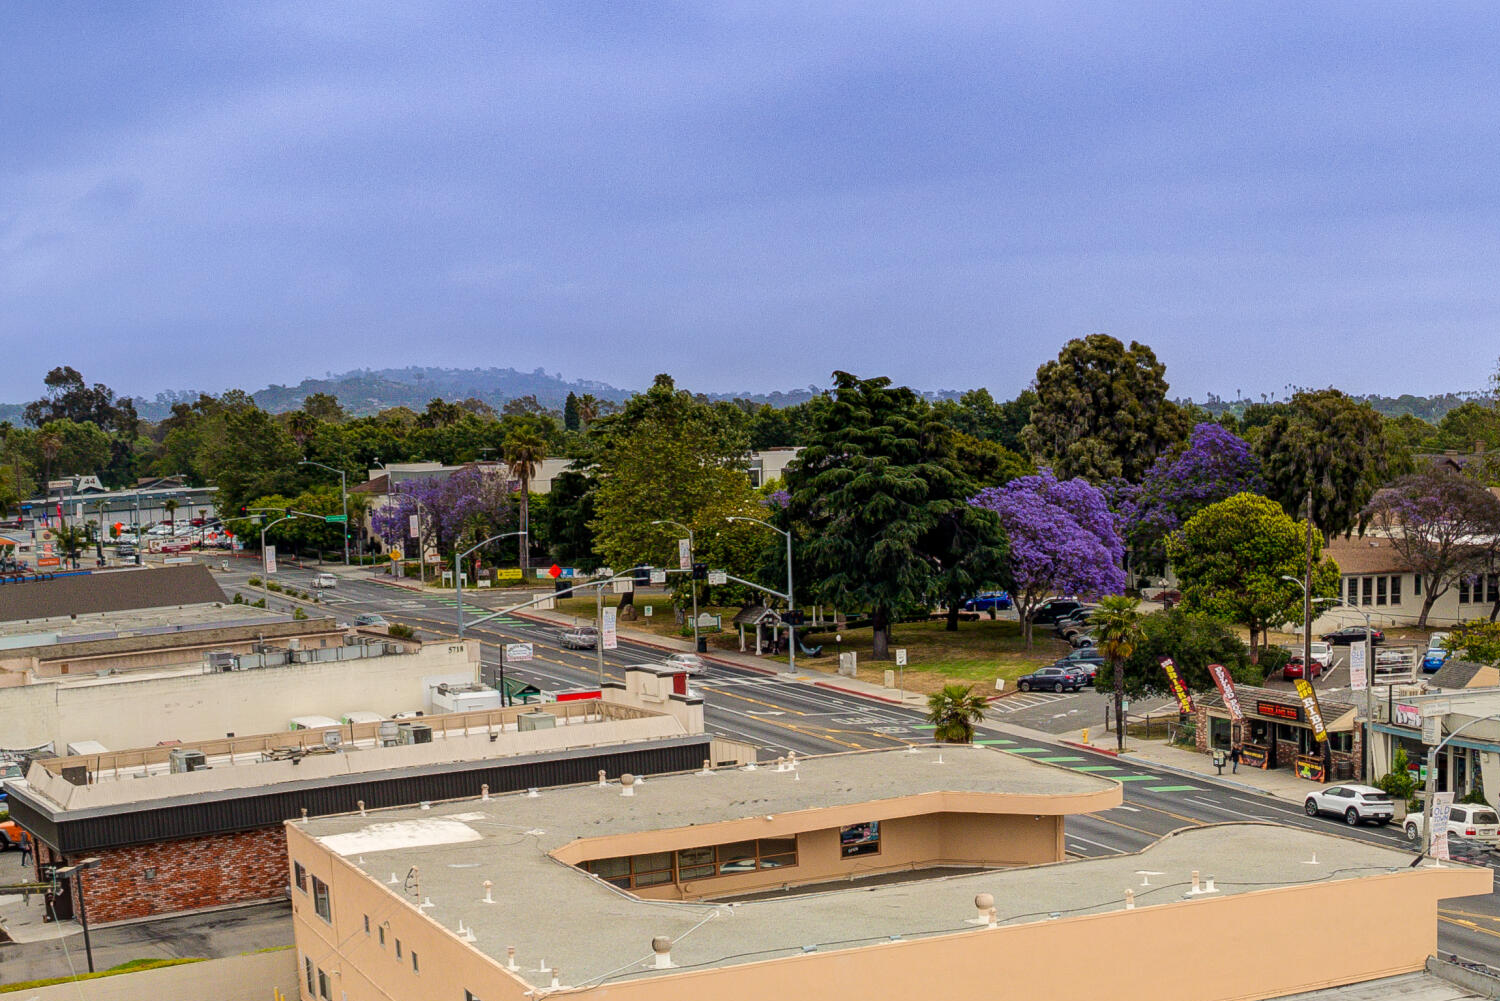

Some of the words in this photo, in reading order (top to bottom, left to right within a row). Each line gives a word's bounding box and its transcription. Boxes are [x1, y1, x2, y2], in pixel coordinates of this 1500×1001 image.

[448, 645, 464, 654] 5718
[1166, 665, 1190, 712] BRISKET
[1302, 697, 1324, 734] RIBS
[1434, 804, 1450, 816] OLD
